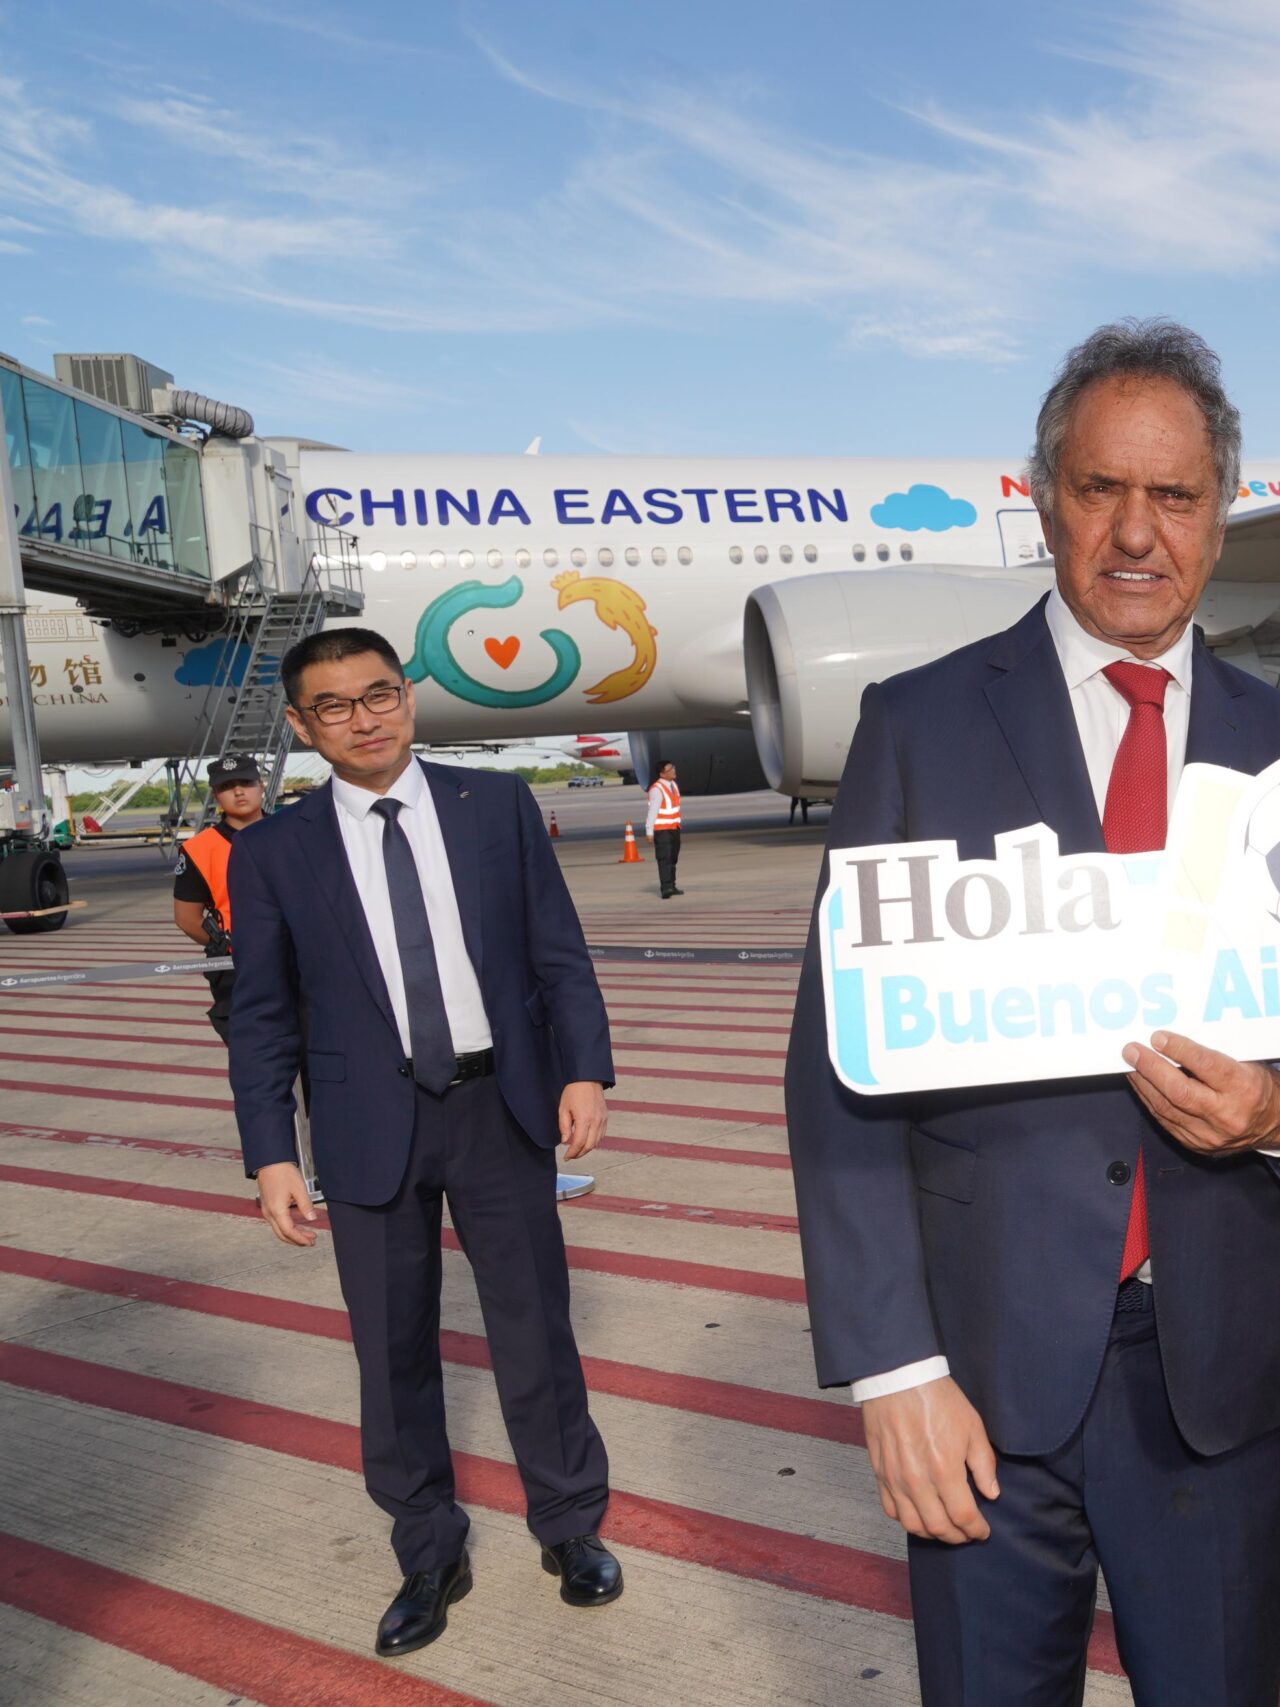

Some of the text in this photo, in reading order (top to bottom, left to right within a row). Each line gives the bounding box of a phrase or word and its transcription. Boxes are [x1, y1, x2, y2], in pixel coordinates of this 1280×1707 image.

[305, 488, 848, 526] CHINA EASTERN
[880, 971, 1178, 1051] Buenos
